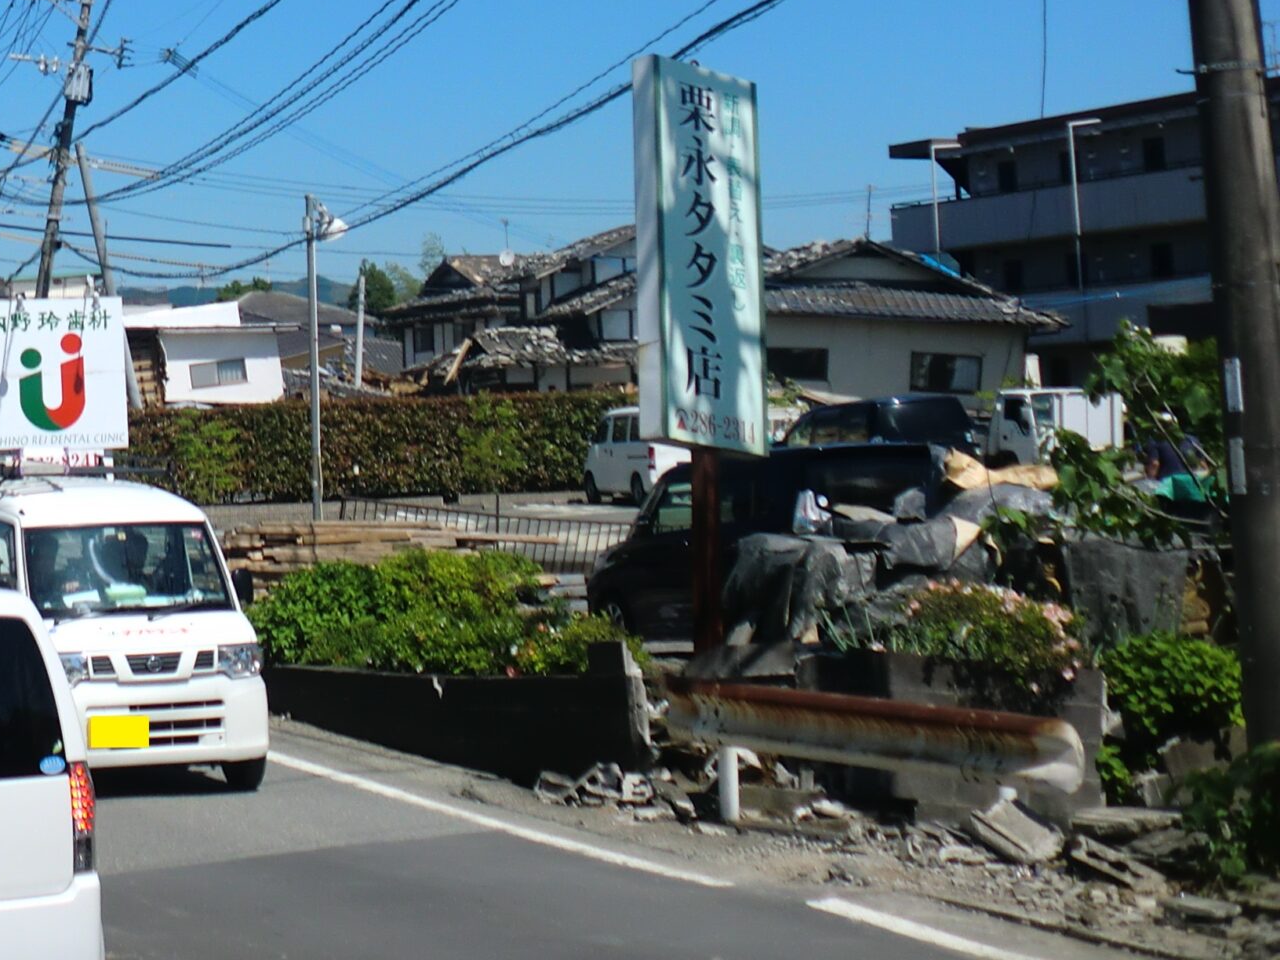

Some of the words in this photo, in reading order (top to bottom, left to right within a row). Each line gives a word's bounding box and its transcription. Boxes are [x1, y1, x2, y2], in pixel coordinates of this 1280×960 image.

[678, 81, 723, 401] 栗永タタミ店
[51, 433, 90, 445] DENTAL
